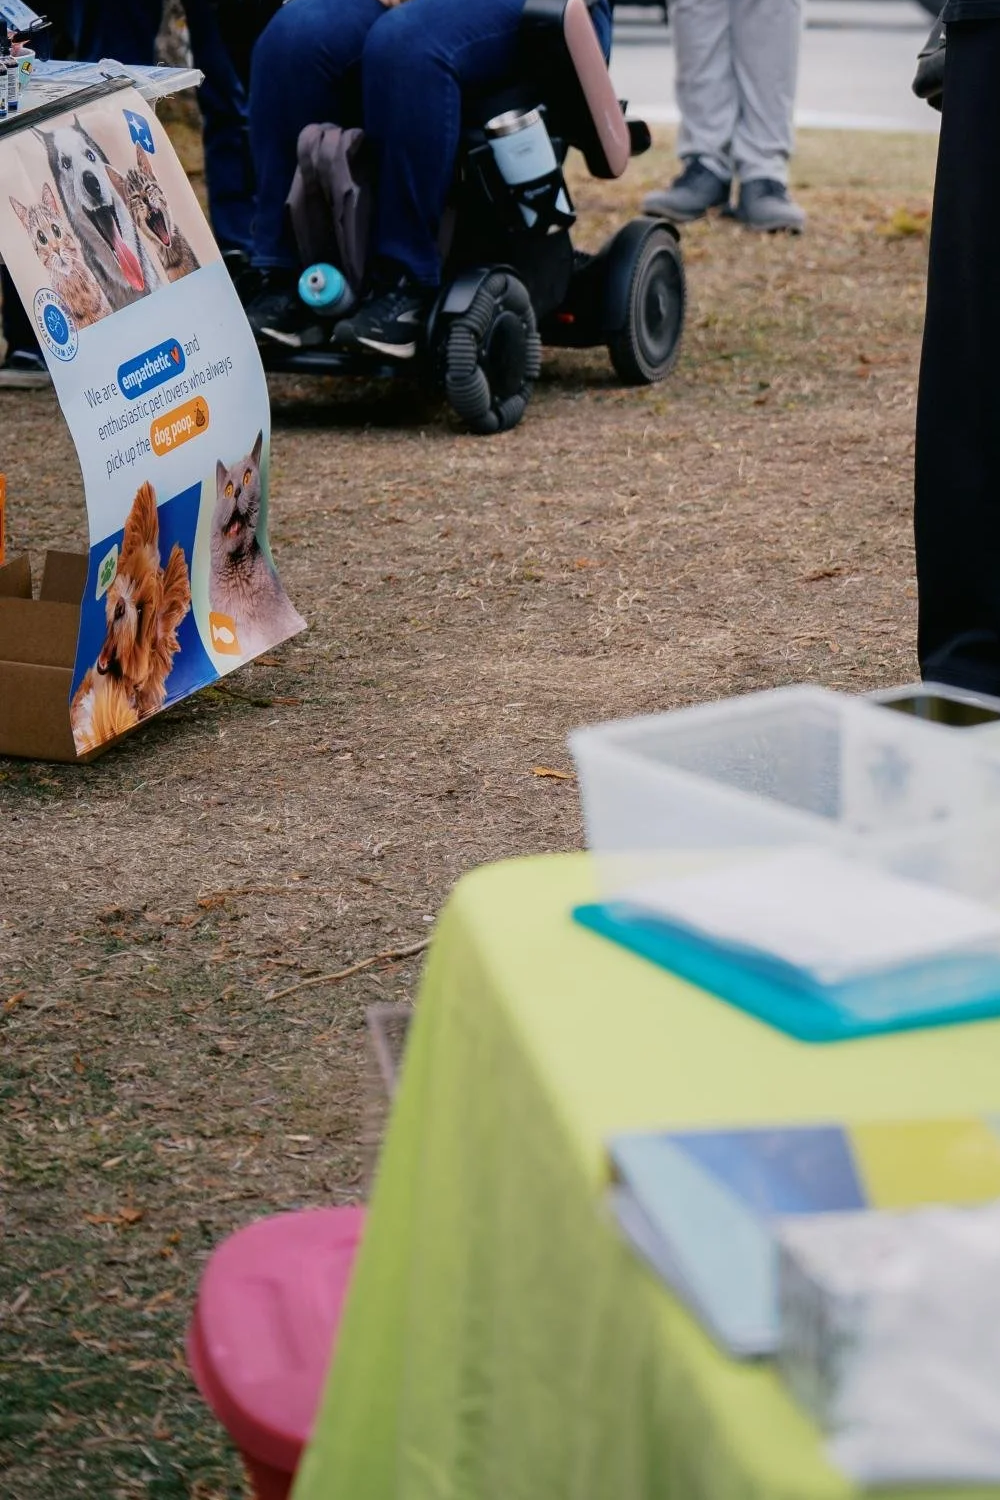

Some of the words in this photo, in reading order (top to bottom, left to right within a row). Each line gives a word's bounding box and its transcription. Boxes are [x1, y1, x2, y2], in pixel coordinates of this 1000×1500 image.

[84, 387, 102, 409] We
[104, 382, 119, 401] are
[122, 351, 171, 390] empathetic
[184, 333, 200, 357] and
[98, 401, 150, 441] enthusiastic
[149, 390, 165, 418] pet
[163, 379, 189, 404] lovers
[188, 369, 206, 391] who
[206, 355, 233, 381] always
[106, 450, 125, 480] pick
[125, 448, 137, 467] up
[136, 437, 151, 455] the
[154, 427, 172, 447] dog
[171, 414, 195, 442] poop.
